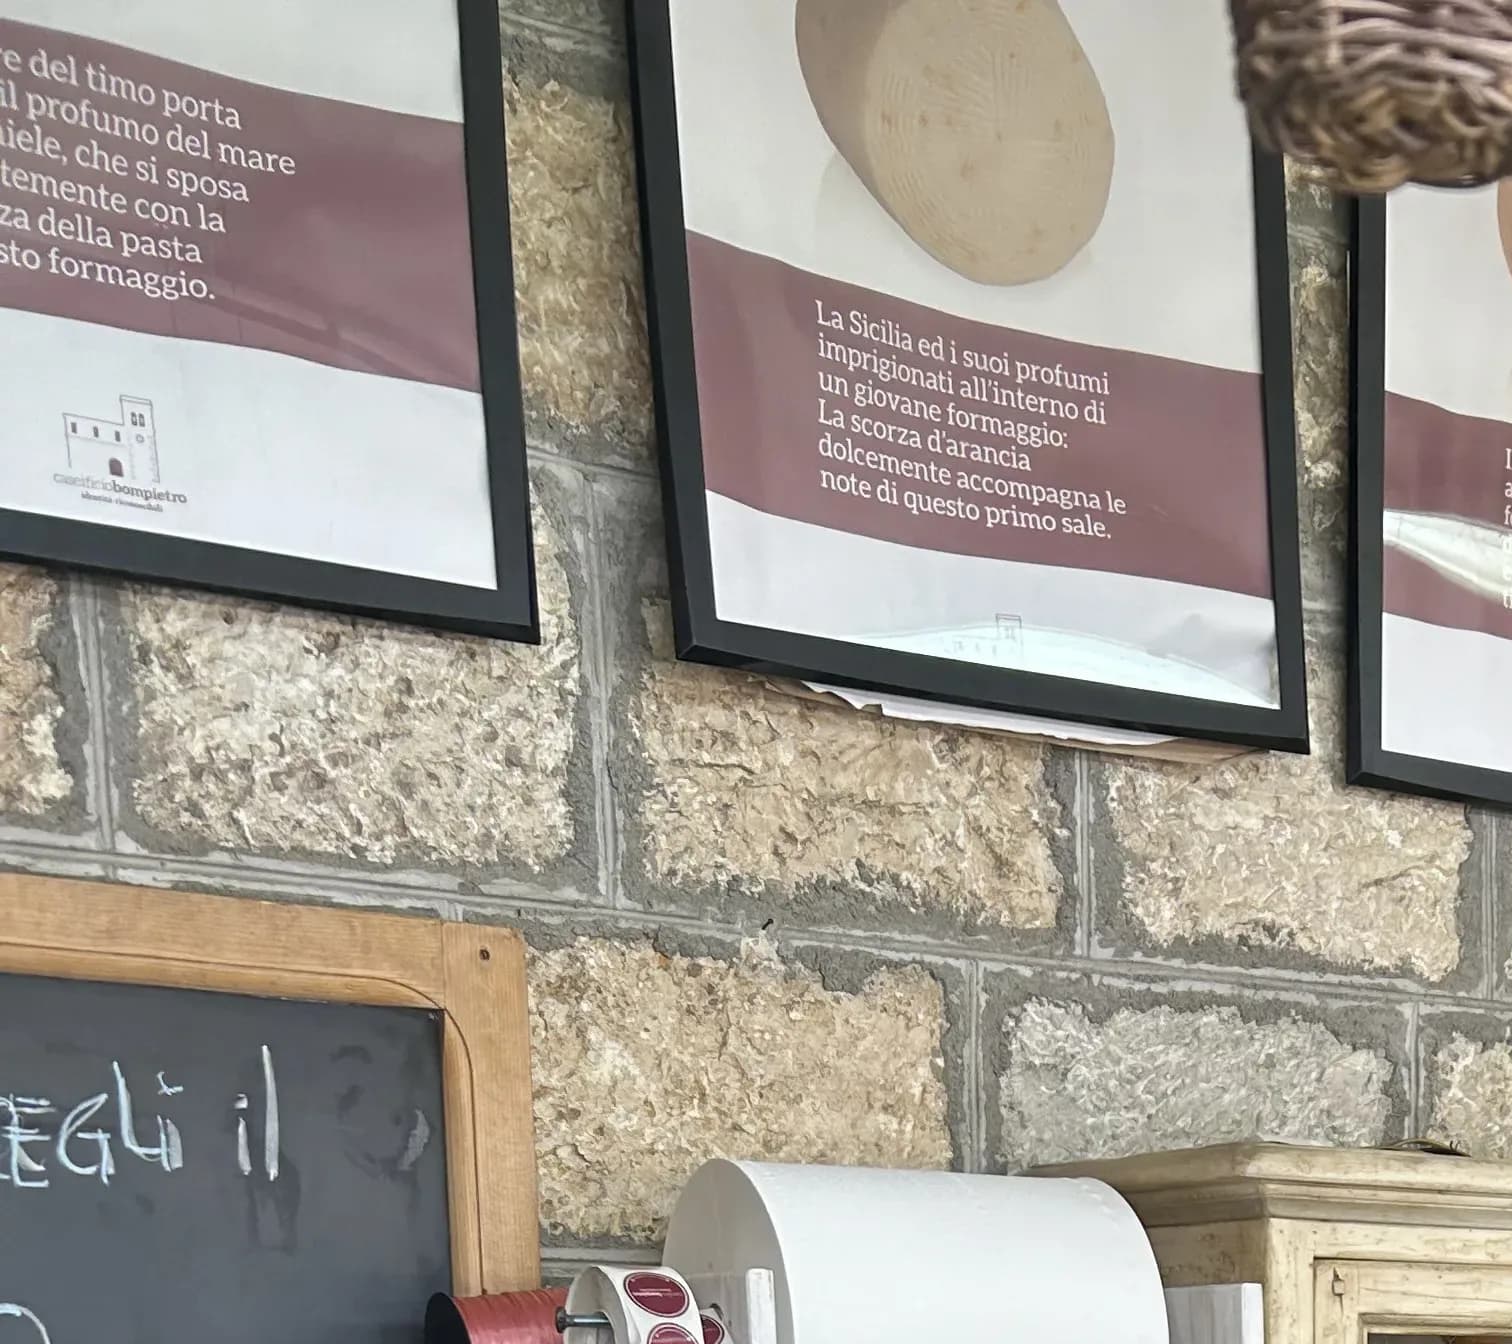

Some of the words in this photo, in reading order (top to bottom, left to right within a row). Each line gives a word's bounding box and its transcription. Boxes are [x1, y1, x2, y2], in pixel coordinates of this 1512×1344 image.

[30, 49, 78, 86] del
[86, 63, 156, 106] timo
[162, 89, 242, 130] porta
[0, 119, 68, 165] iele,
[74, 140, 128, 176] che
[136, 156, 159, 184] si
[167, 168, 249, 202] sposa
[26, 89, 160, 146] profumo
[166, 124, 212, 159] del
[217, 141, 296, 175] mare
[38, 207, 113, 249] della
[120, 230, 204, 263] pasta
[134, 199, 190, 228] con
[199, 203, 226, 233] la
[49, 246, 215, 300] formaggio.
[815, 300, 844, 330] La
[849, 310, 913, 352] Sicilia
[918, 336, 944, 361] ed
[950, 341, 958, 365] i
[962, 347, 1010, 376] suoi
[1016, 359, 1110, 395] profumi
[818, 333, 954, 395] imprigionati
[960, 376, 1078, 420] all'interno
[1084, 401, 1106, 425] di
[818, 371, 849, 399] un
[854, 381, 942, 423] giovane
[946, 402, 1068, 449] formaggio:
[818, 398, 845, 429] La
[851, 413, 922, 449] scorza
[927, 429, 1031, 472] d'arancia
[818, 433, 952, 486] dolcemente
[956, 471, 1101, 513] accompagna
[1106, 491, 1127, 515] le
[820, 468, 872, 499] note
[877, 480, 899, 505] di
[904, 488, 980, 521] questo
[985, 504, 1057, 531] primo
[1061, 512, 1112, 539] sale.
